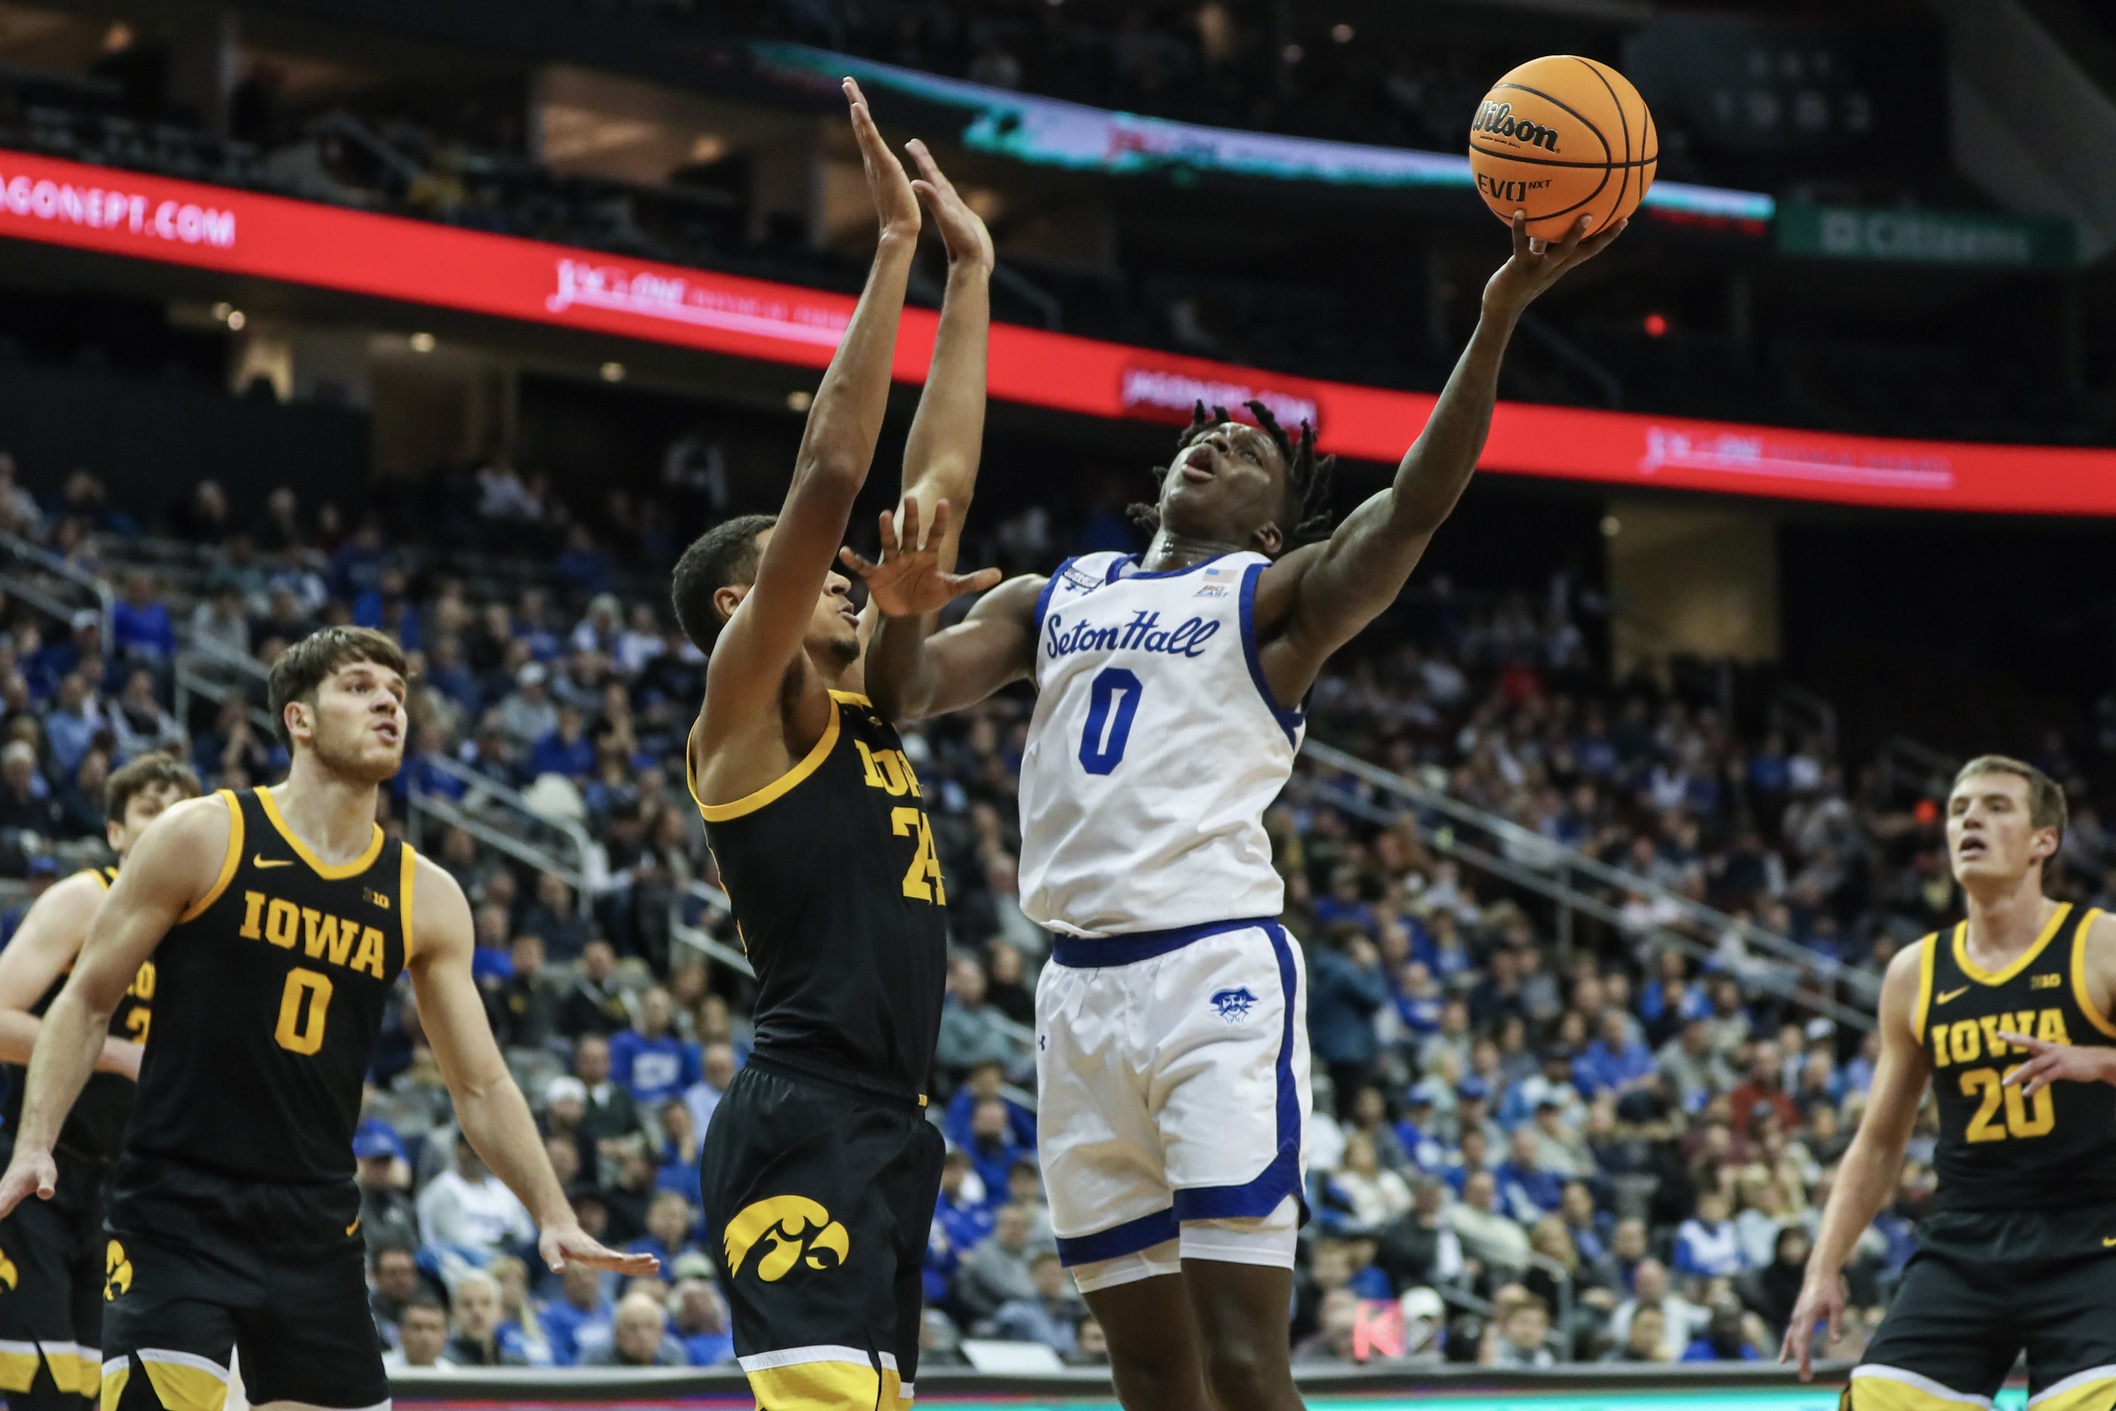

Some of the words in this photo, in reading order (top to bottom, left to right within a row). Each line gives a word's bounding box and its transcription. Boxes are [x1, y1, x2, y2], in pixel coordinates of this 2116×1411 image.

[1473, 100, 1558, 153] Wilson
[1046, 613, 1118, 659] Seton
[1119, 609, 1221, 658] Hall
[1078, 667, 1143, 776] 0
[239, 889, 385, 980] IOWA
[274, 966, 334, 1056] 0
[1931, 1007, 2073, 1068] IOWA
[1959, 1063, 2056, 1144] 20
